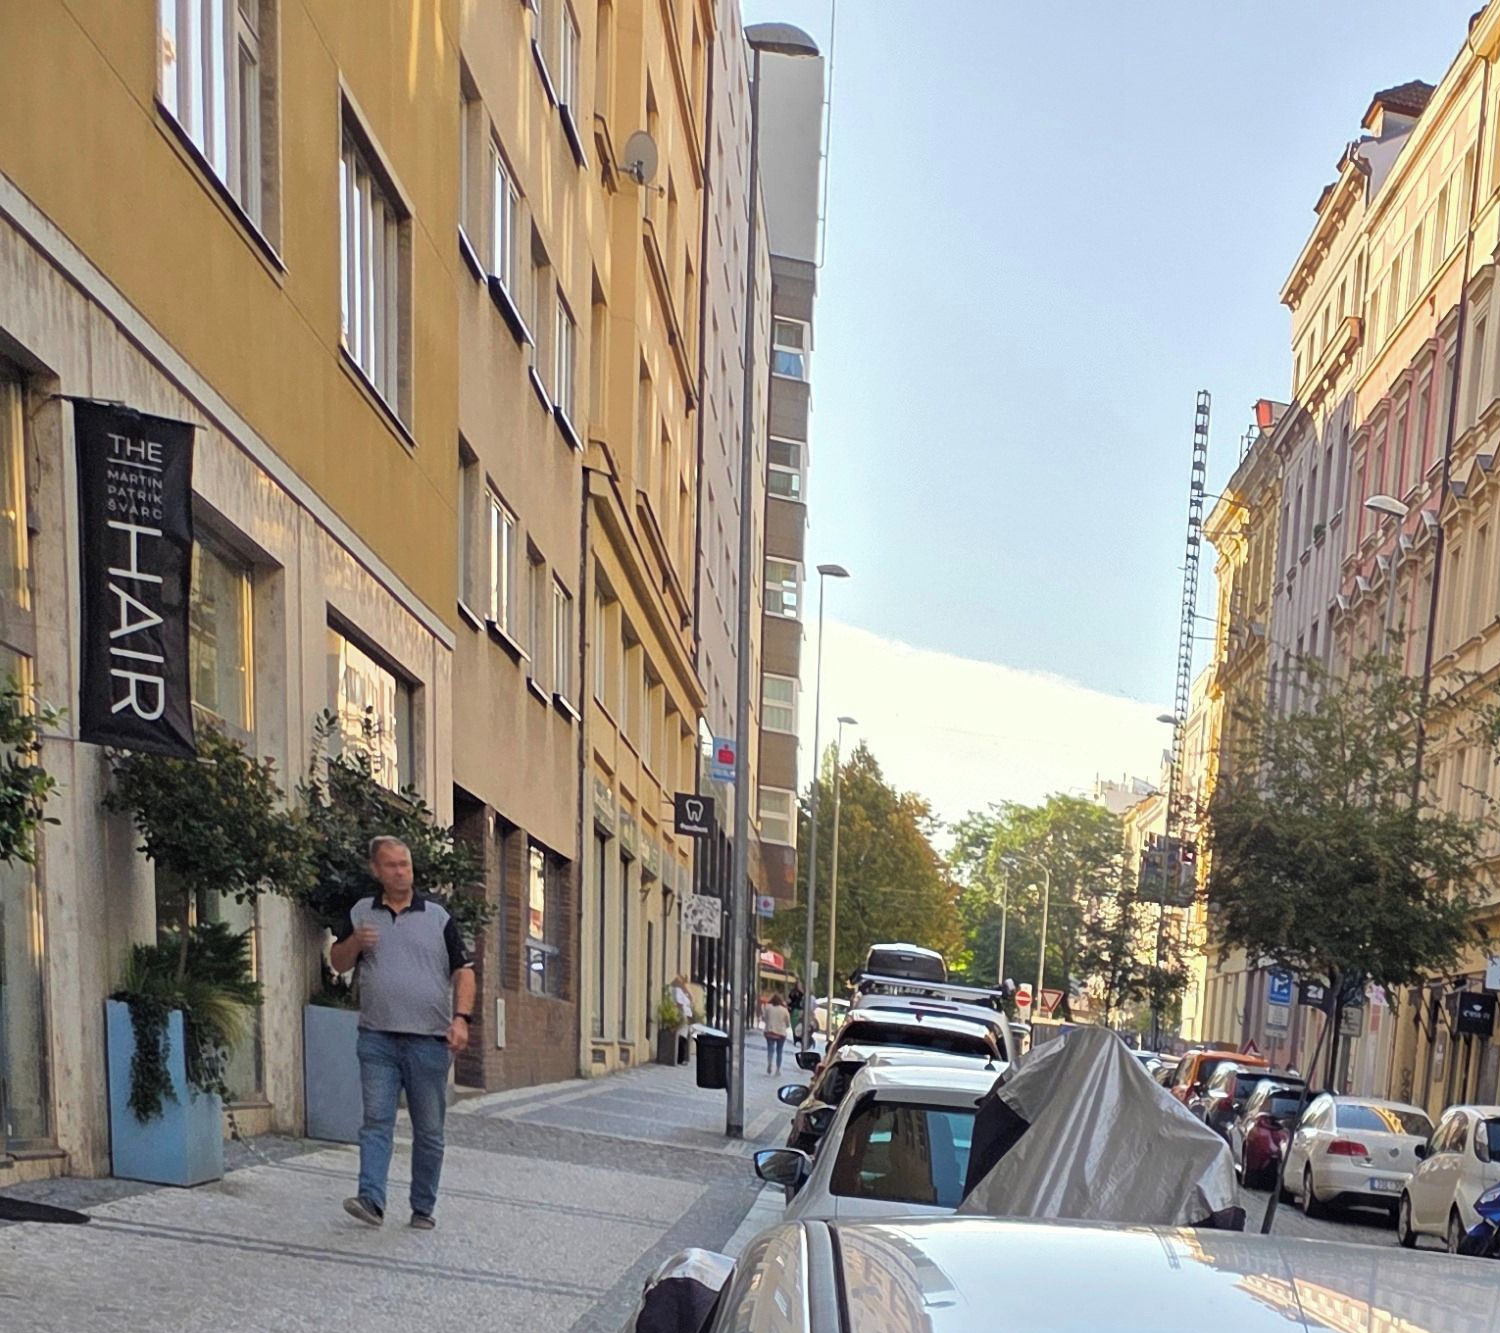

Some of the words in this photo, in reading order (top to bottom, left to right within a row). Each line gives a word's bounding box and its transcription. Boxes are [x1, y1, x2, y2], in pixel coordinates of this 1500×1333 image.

[107, 432, 163, 464] THE
[107, 469, 163, 489] MARTIN
[107, 484, 163, 505] PATRIK
[107, 520, 165, 721] HAIR
